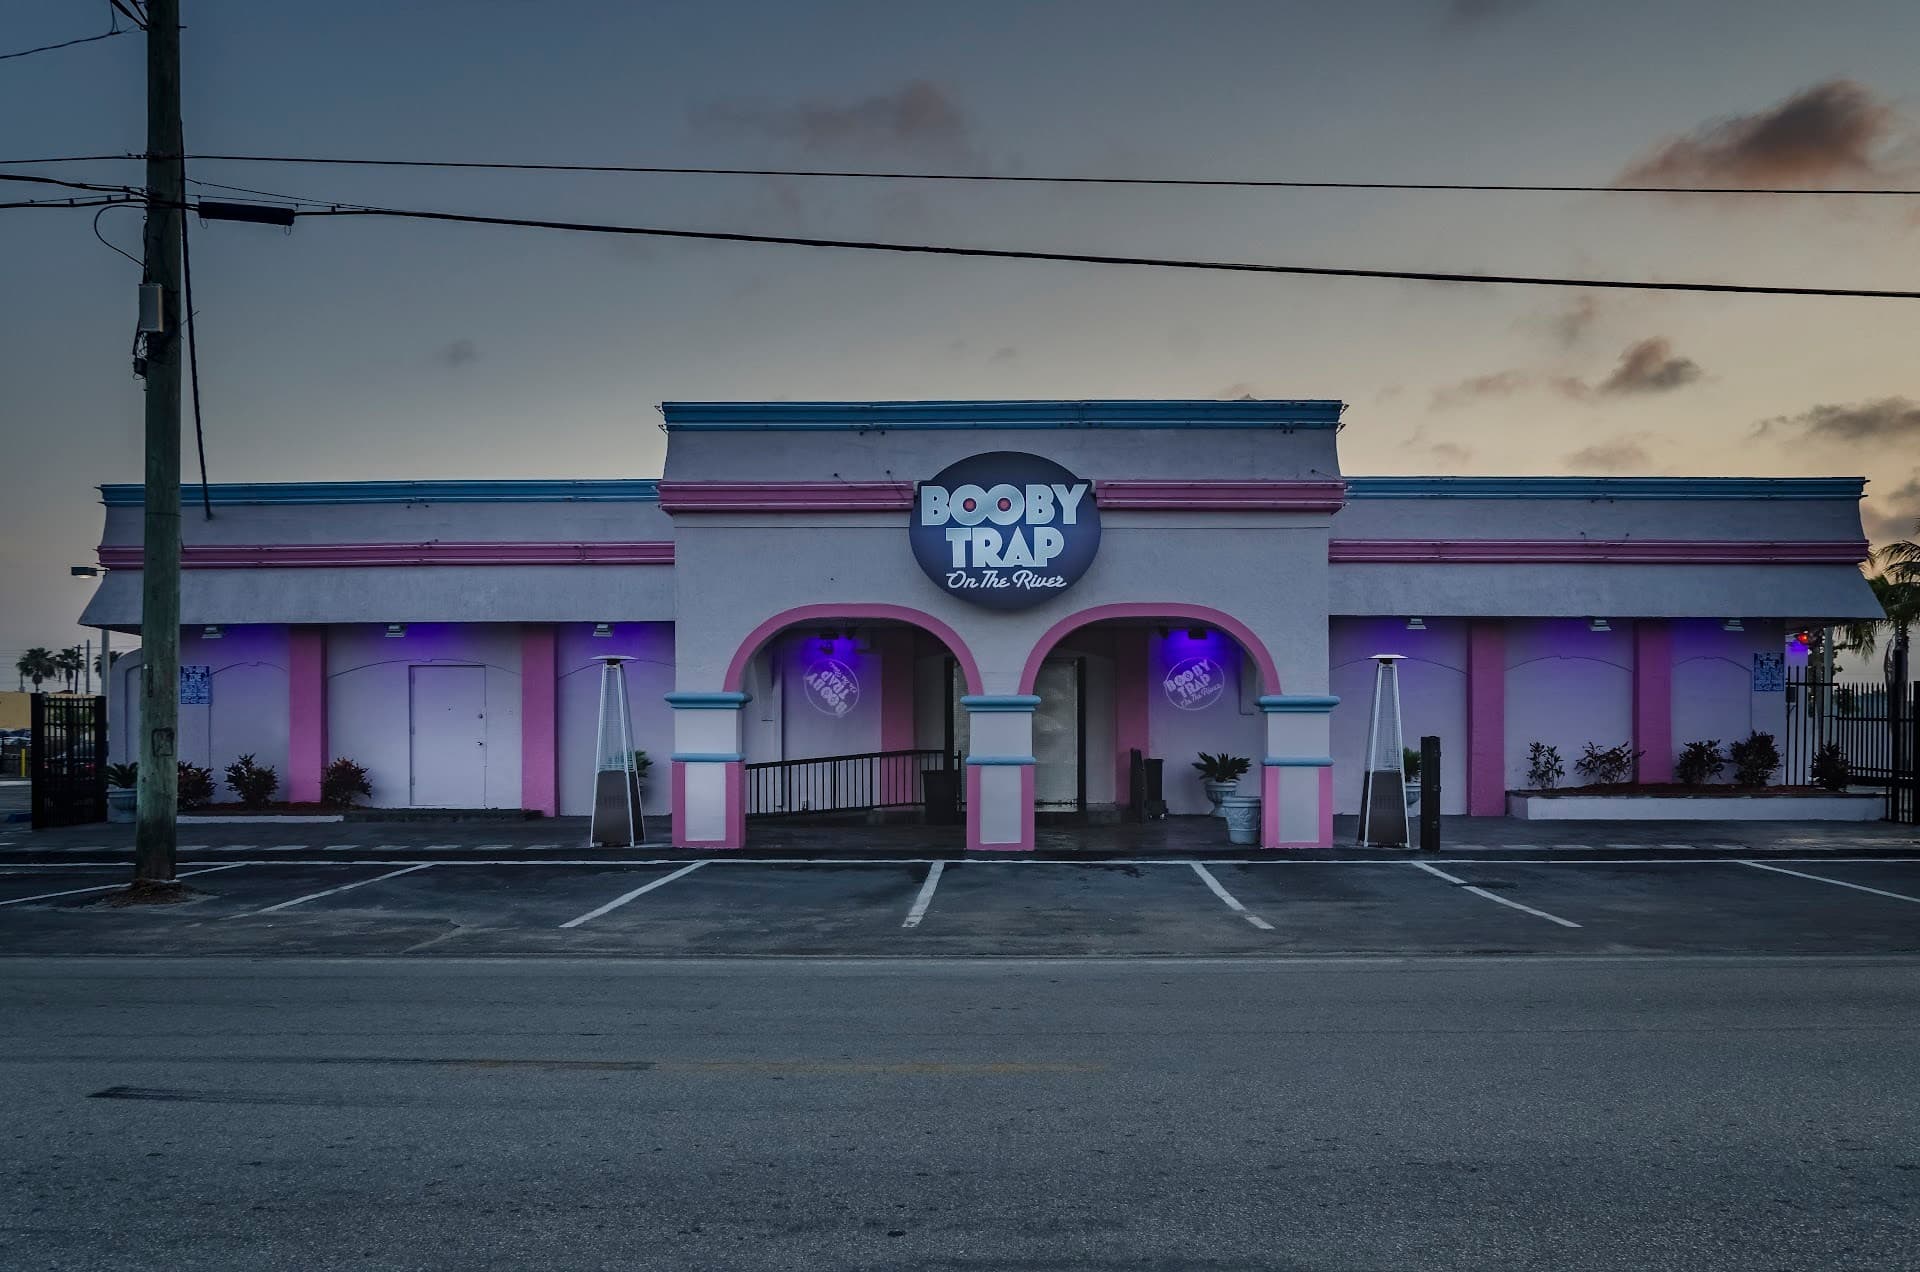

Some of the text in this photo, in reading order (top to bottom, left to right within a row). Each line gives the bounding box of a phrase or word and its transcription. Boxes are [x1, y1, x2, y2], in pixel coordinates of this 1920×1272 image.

[921, 483, 1089, 526] BOOBY
[946, 526, 1065, 568] TRAP
[946, 569, 1068, 590] On The River
[1163, 659, 1210, 692] BOOBY
[1177, 674, 1210, 698] TRAP
